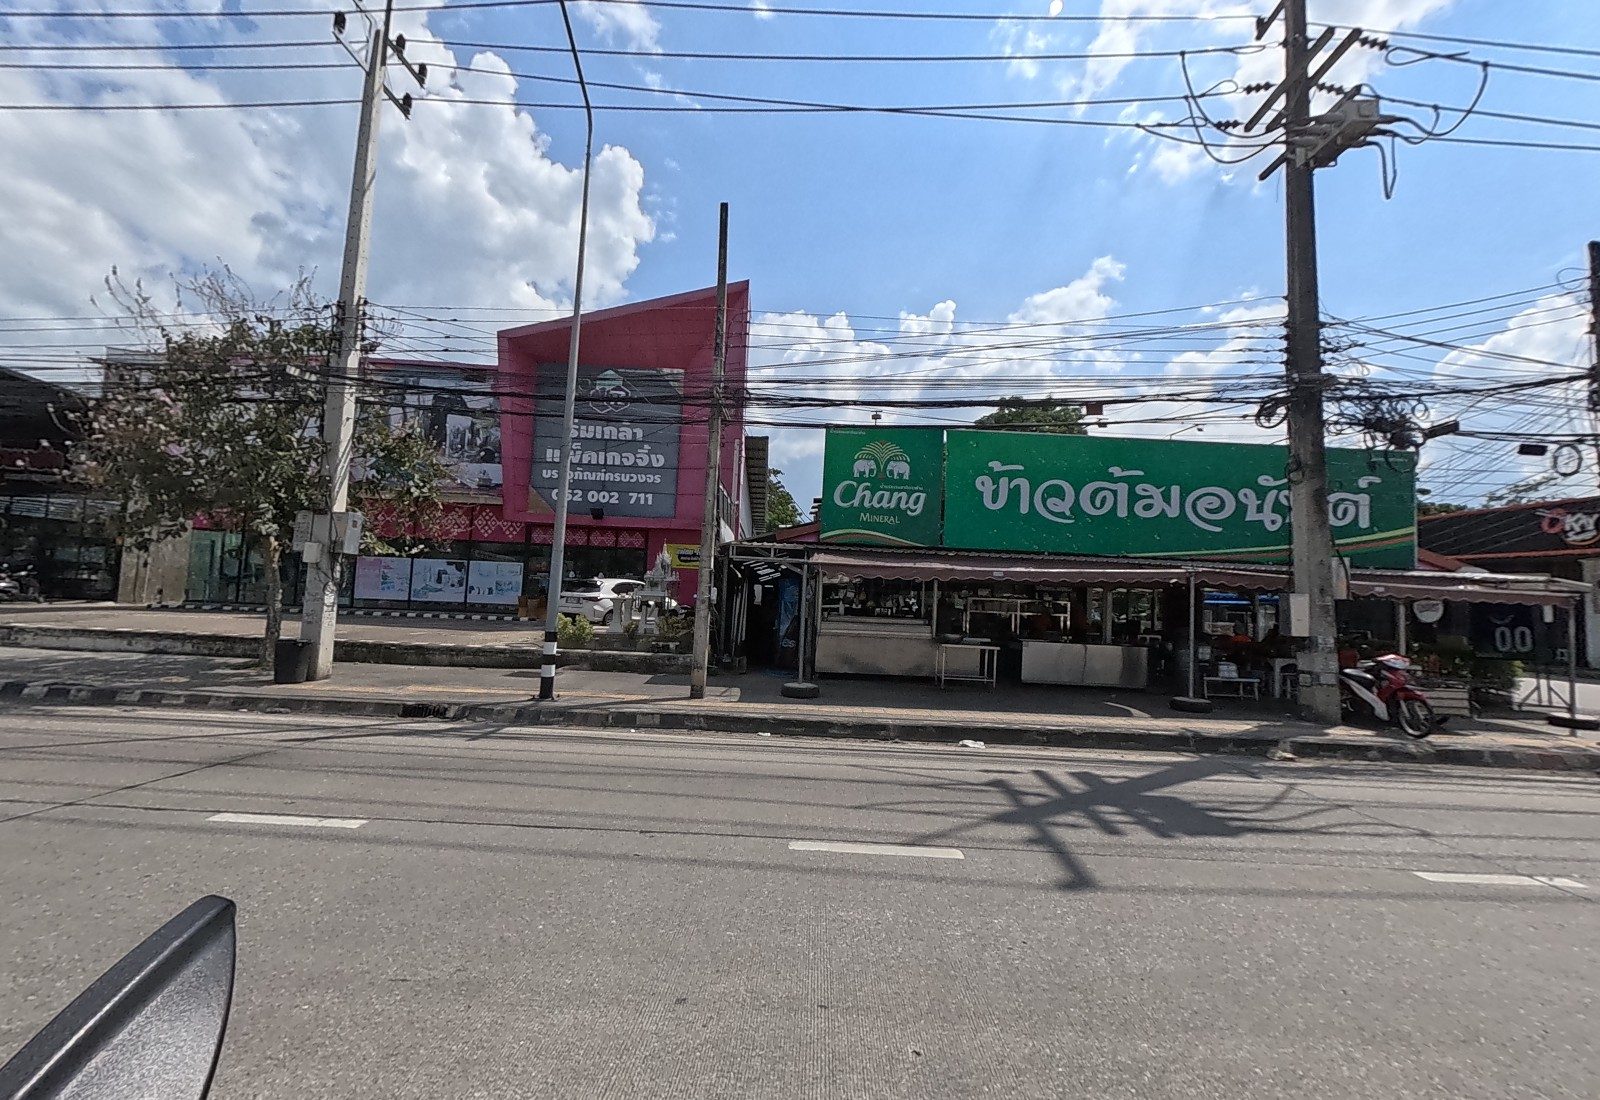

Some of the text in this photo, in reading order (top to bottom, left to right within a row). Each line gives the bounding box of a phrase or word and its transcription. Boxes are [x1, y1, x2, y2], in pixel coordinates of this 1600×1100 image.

[541, 467, 662, 484] บรจุภัณฑ์ครบวงจร
[587, 490, 620, 504] 002
[628, 492, 654, 506] 711
[833, 480, 928, 517] Chang
[975, 461, 1383, 532] ข้าวต้มอนัต์
[859, 512, 902, 525] MINERAL
